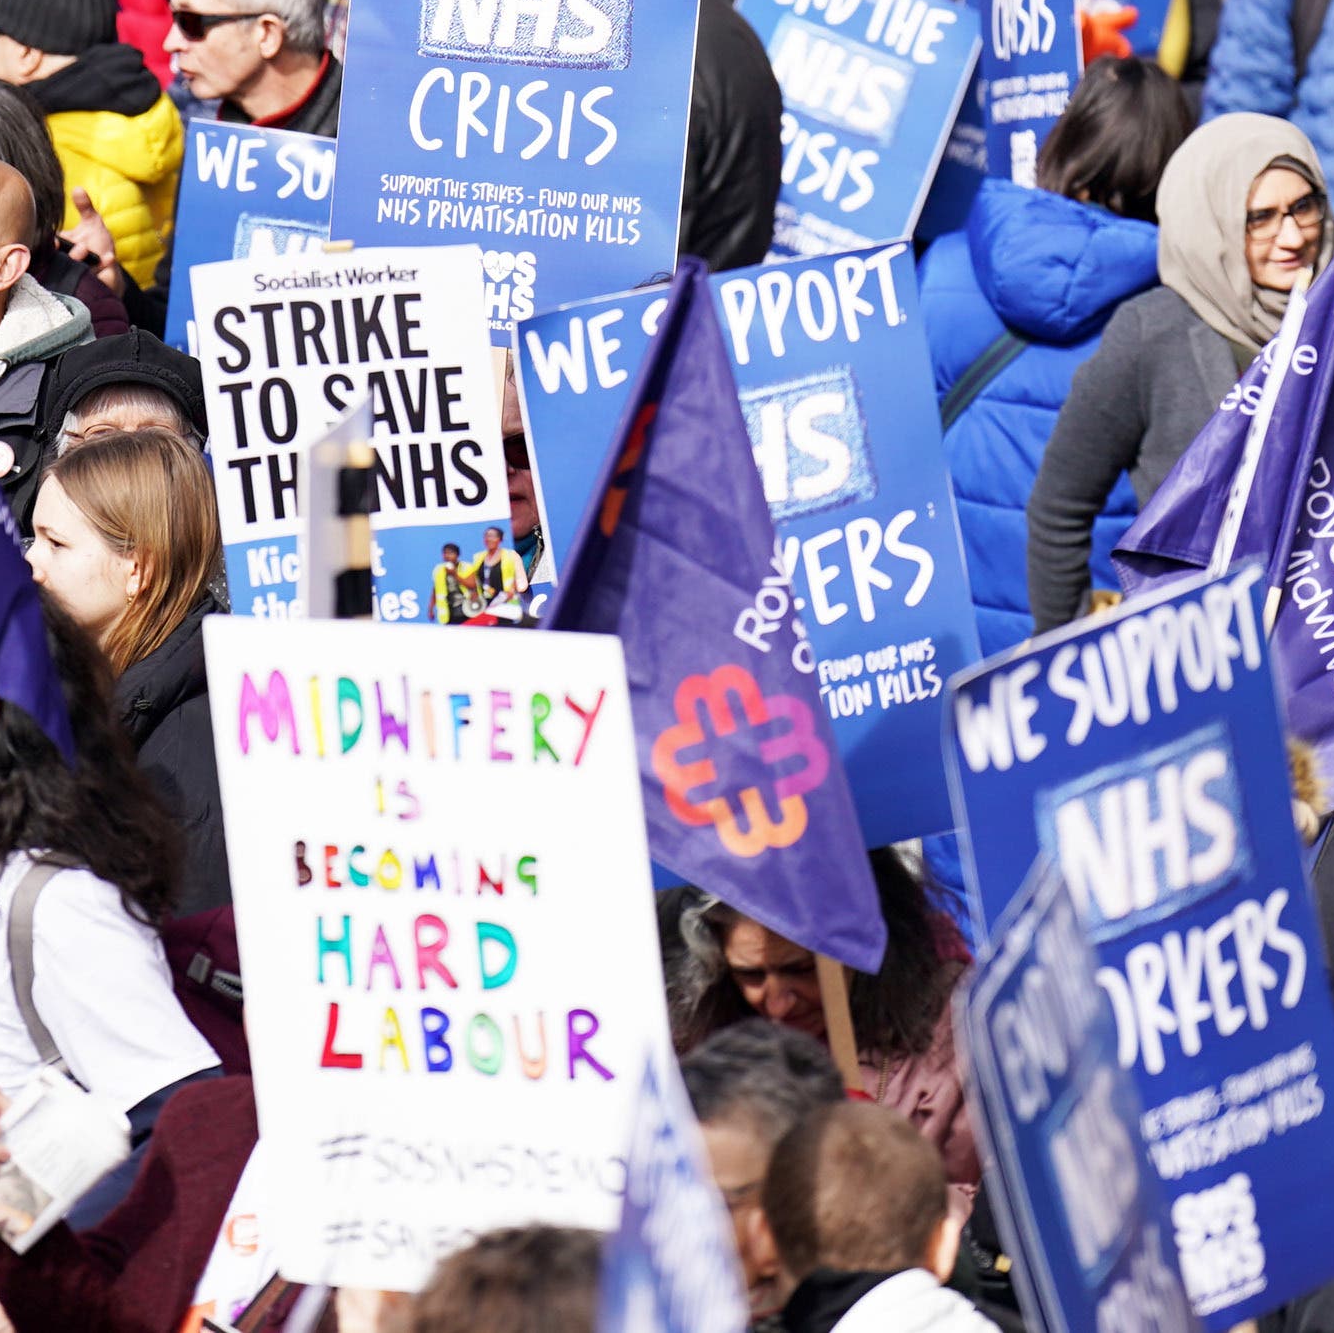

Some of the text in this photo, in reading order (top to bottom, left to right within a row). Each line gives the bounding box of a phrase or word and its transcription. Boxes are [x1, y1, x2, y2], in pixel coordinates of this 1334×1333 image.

[409, 67, 619, 166] CRISIS
[772, 27, 906, 135] NHS
[196, 130, 267, 192] WE
[380, 173, 642, 215] SUPPORT THE STRIKES FUND OUR NHS
[378, 198, 641, 247] NHS PRIVATISATION KILLS
[254, 266, 419, 294] Socialist Worker
[213, 293, 429, 375] STRIKE
[526, 308, 628, 395] WE
[219, 366, 469, 449] TO SAVE
[371, 440, 488, 513] NHS
[248, 546, 300, 587] Kic
[818, 637, 936, 684] FUND OUR NHS
[876, 663, 943, 710] KILLS
[954, 568, 1264, 772] WE SUPPORT
[239, 667, 606, 766] MIDWIFERY
[294, 839, 539, 898] BECOMING
[1056, 748, 1236, 923] NHS
[317, 913, 518, 991] HARD
[320, 1001, 615, 1082] LABOUR
